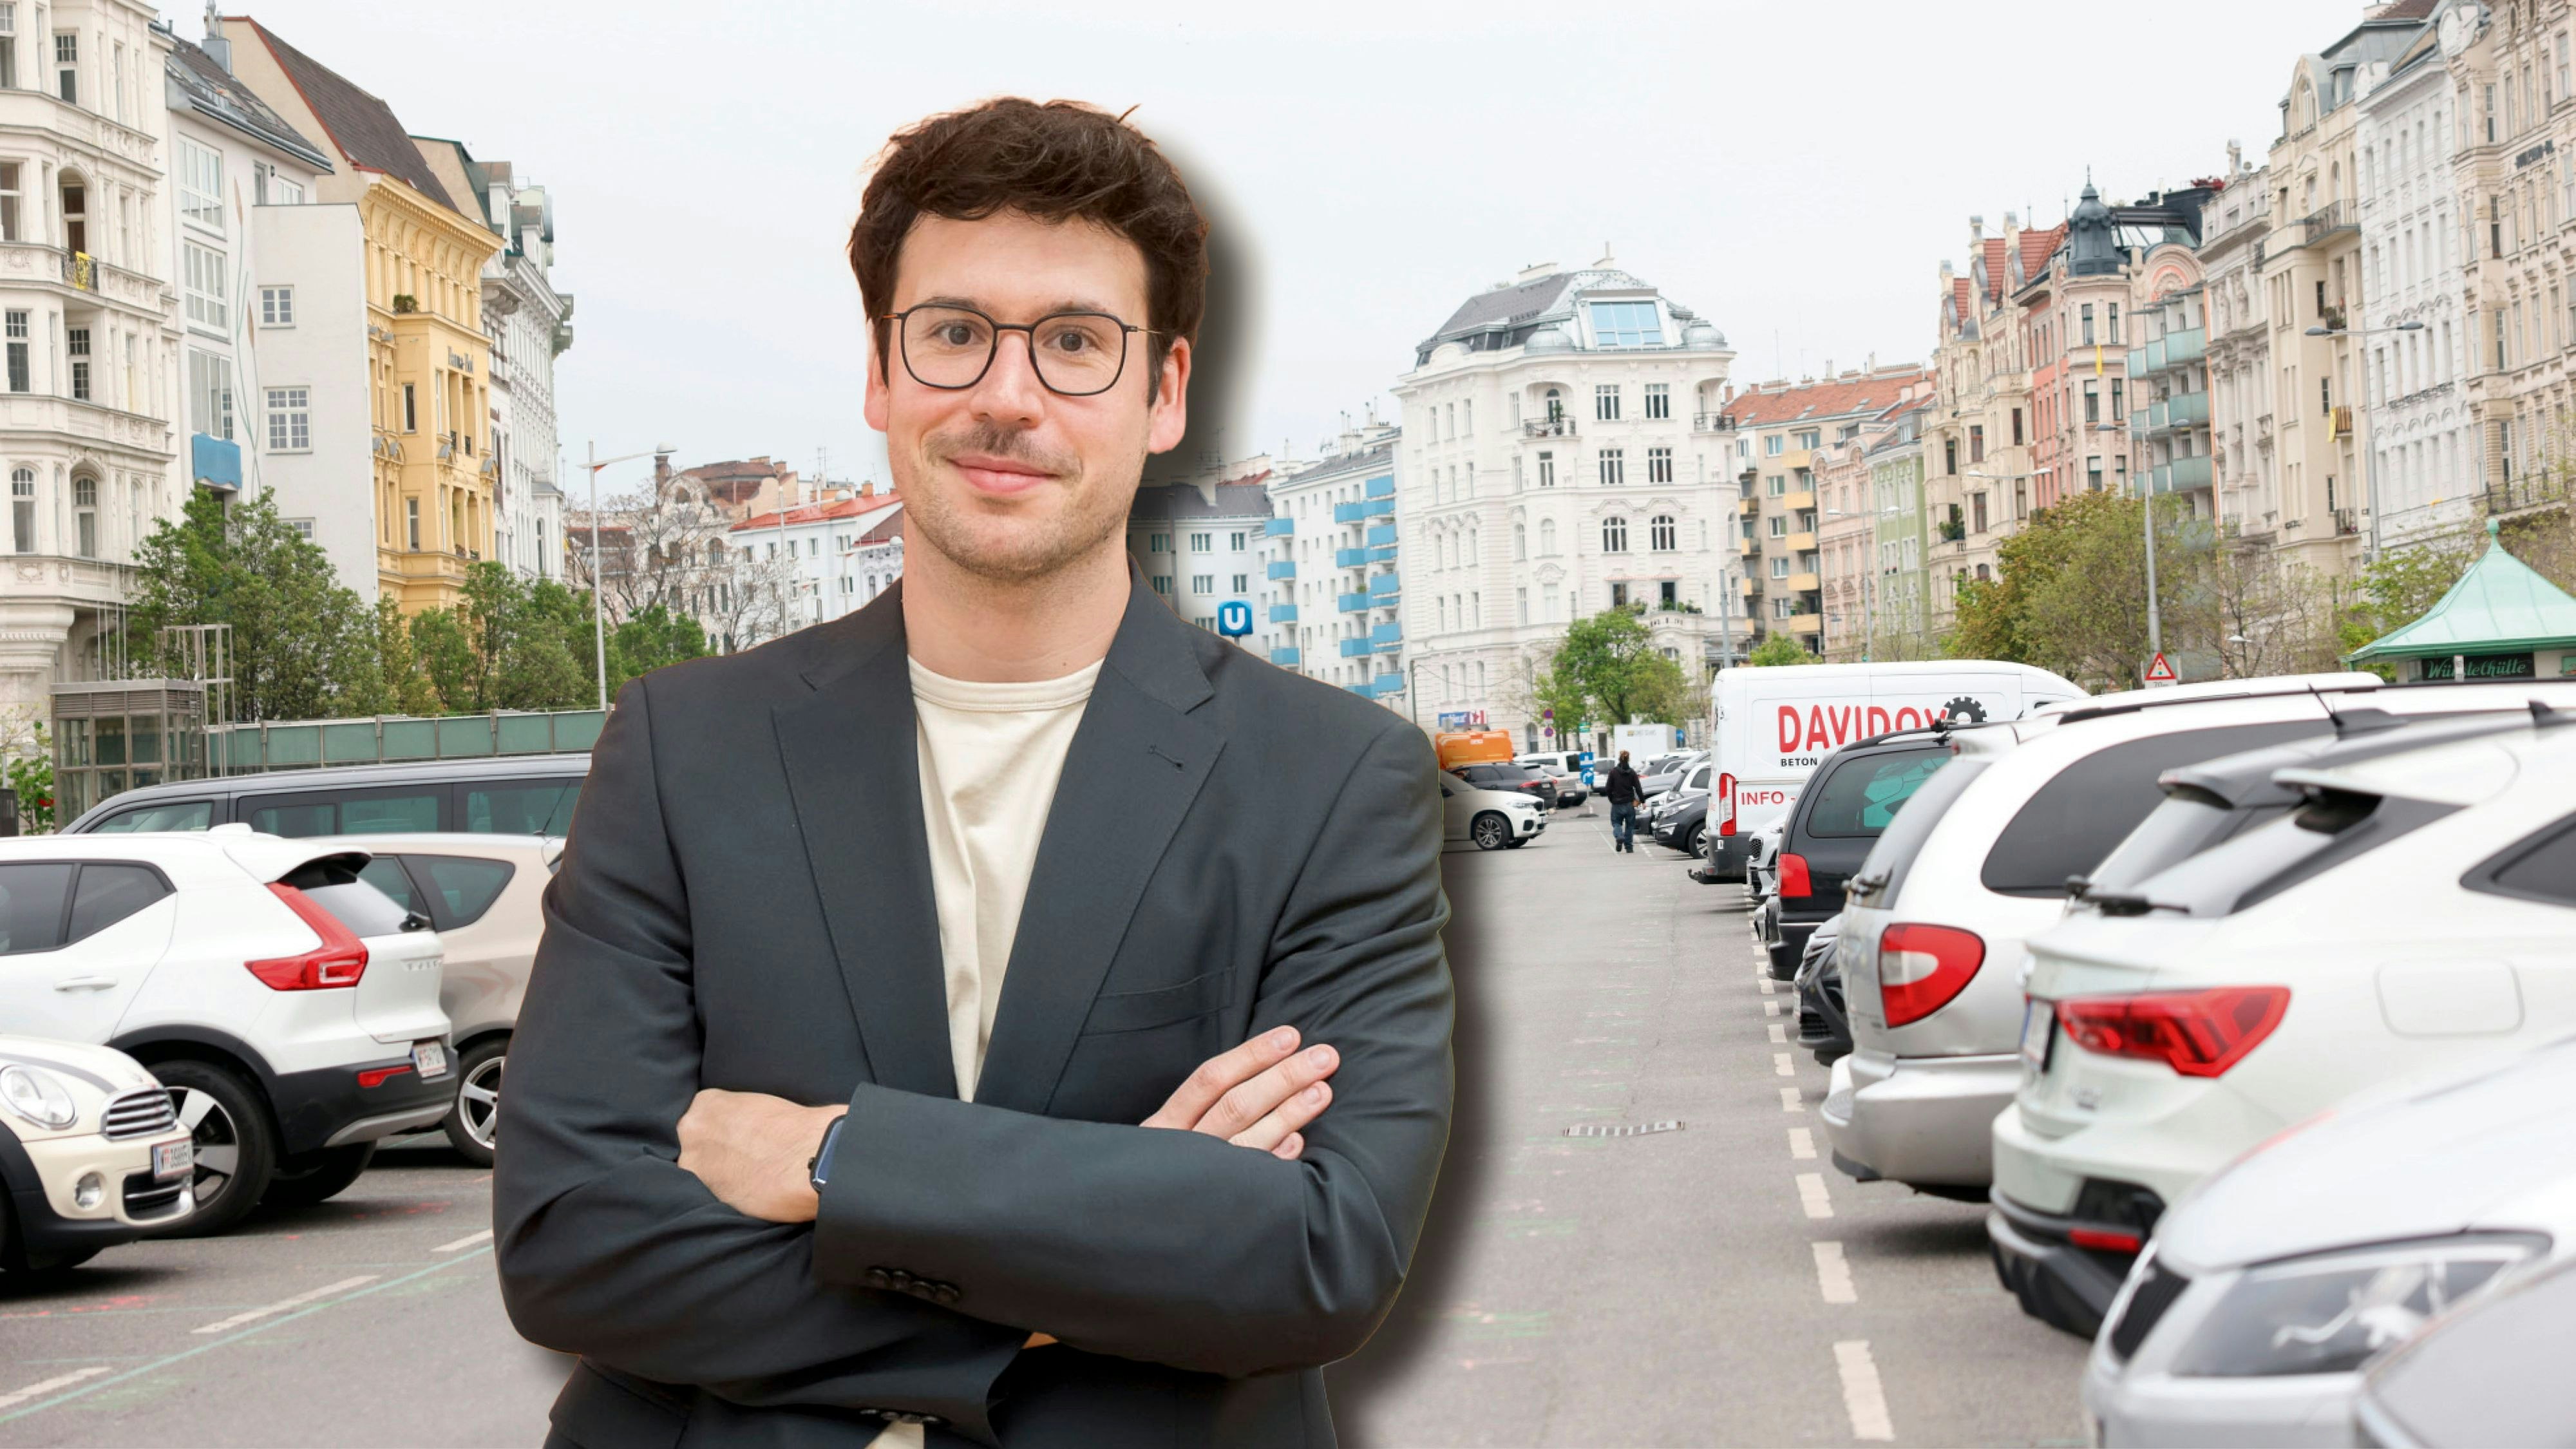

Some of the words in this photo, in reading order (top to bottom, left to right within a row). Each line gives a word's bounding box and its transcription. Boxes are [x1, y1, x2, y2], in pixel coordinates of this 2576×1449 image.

[1224, 607, 1245, 630] U
[1780, 757, 1818, 766] BETON
[1741, 791, 1784, 805] INFO
